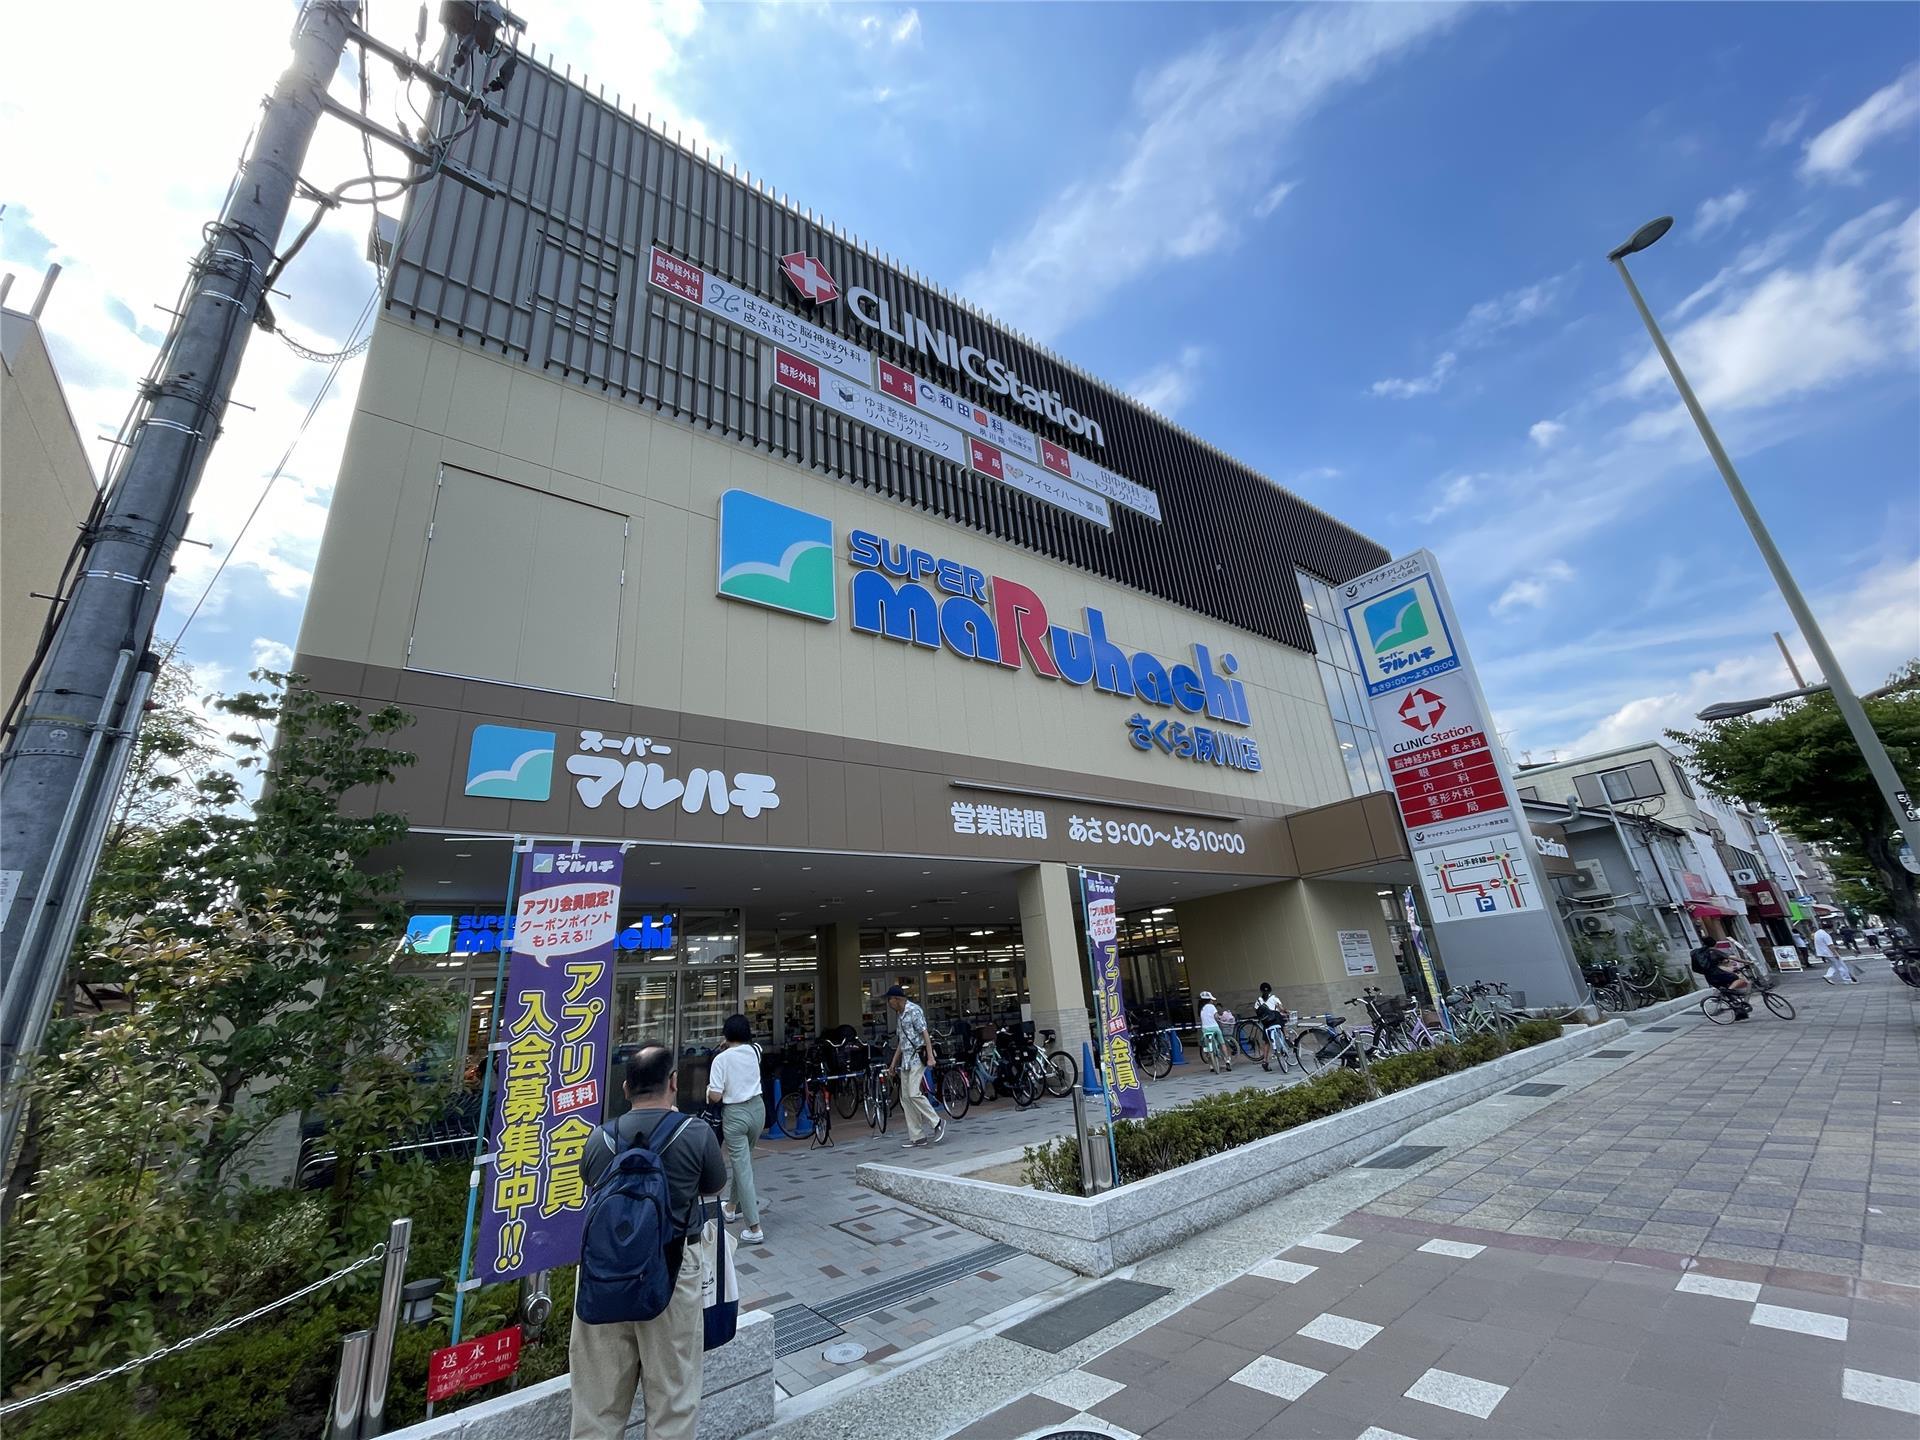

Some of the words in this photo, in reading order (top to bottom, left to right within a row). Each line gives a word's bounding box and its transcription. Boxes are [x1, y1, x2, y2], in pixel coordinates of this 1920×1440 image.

[656, 256, 700, 285] 脳神経外科
[656, 272, 699, 299] 皮ふ科
[743, 312, 844, 365] 皮ふ科クリニック
[780, 362, 817, 388] 整形外科
[864, 396, 929, 432] ゆま整形外科
[866, 408, 949, 451] リハビリクリニック
[1023, 474, 1104, 517] アイセイハート薬局
[1075, 471, 1155, 514] ハートフルクリニック
[848, 528, 988, 603] SUPER
[850, 569, 1252, 728] maRuhachi
[1378, 651, 1404, 663] スーパー
[1379, 646, 1435, 674] マルハチ
[579, 730, 671, 757] スーパー
[1125, 712, 1263, 773] さくら夙川店
[566, 754, 780, 818] マルハチ
[1428, 787, 1475, 806] 整形外科
[950, 801, 1048, 840] 営業時間
[556, 860, 615, 874] マルハチ
[557, 853, 586, 861] スーパー
[1456, 856, 1487, 868] 山手幹線
[523, 889, 614, 916] アプリ会員限定!
[520, 911, 612, 934] クーポンポイント
[561, 961, 605, 1085] アプリ
[556, 1085, 594, 1110] 無料
[540, 1116, 595, 1219] 会員
[441, 1337, 510, 1369] 送水口
